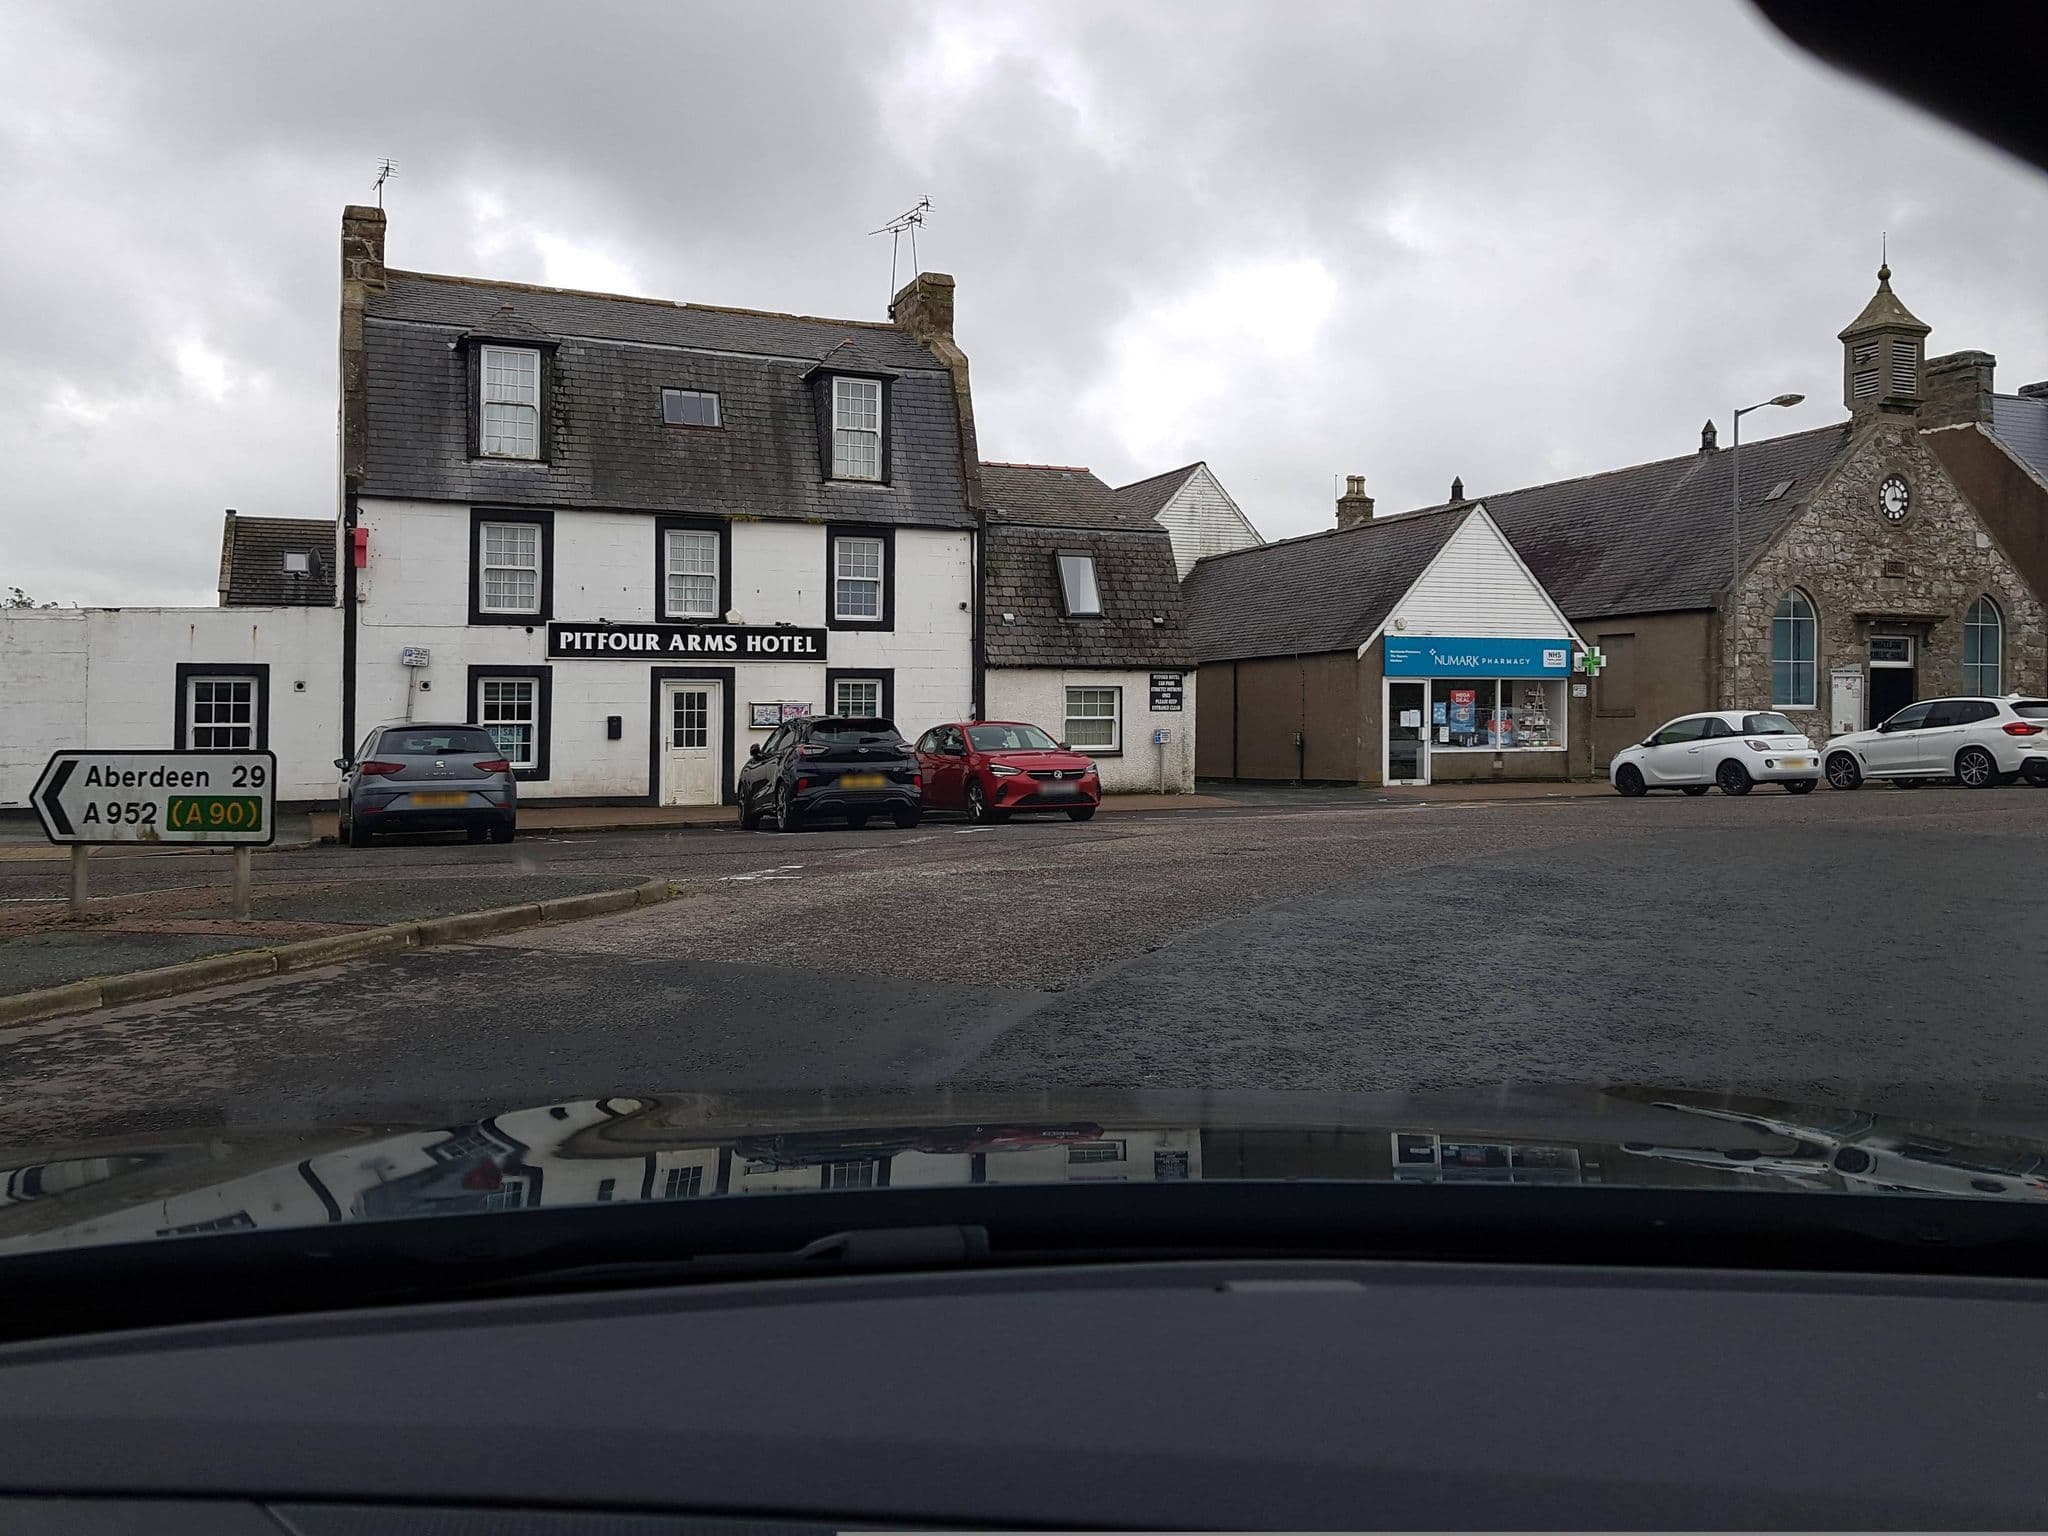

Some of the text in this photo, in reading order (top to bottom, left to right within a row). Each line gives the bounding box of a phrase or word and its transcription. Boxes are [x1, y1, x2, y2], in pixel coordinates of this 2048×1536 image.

[560, 631, 817, 653] PITFOUR ARMS HOTEL
[1434, 655, 1480, 667] NUMARK
[84, 765, 266, 788] Aberdeen 29
[83, 802, 157, 825] A952
